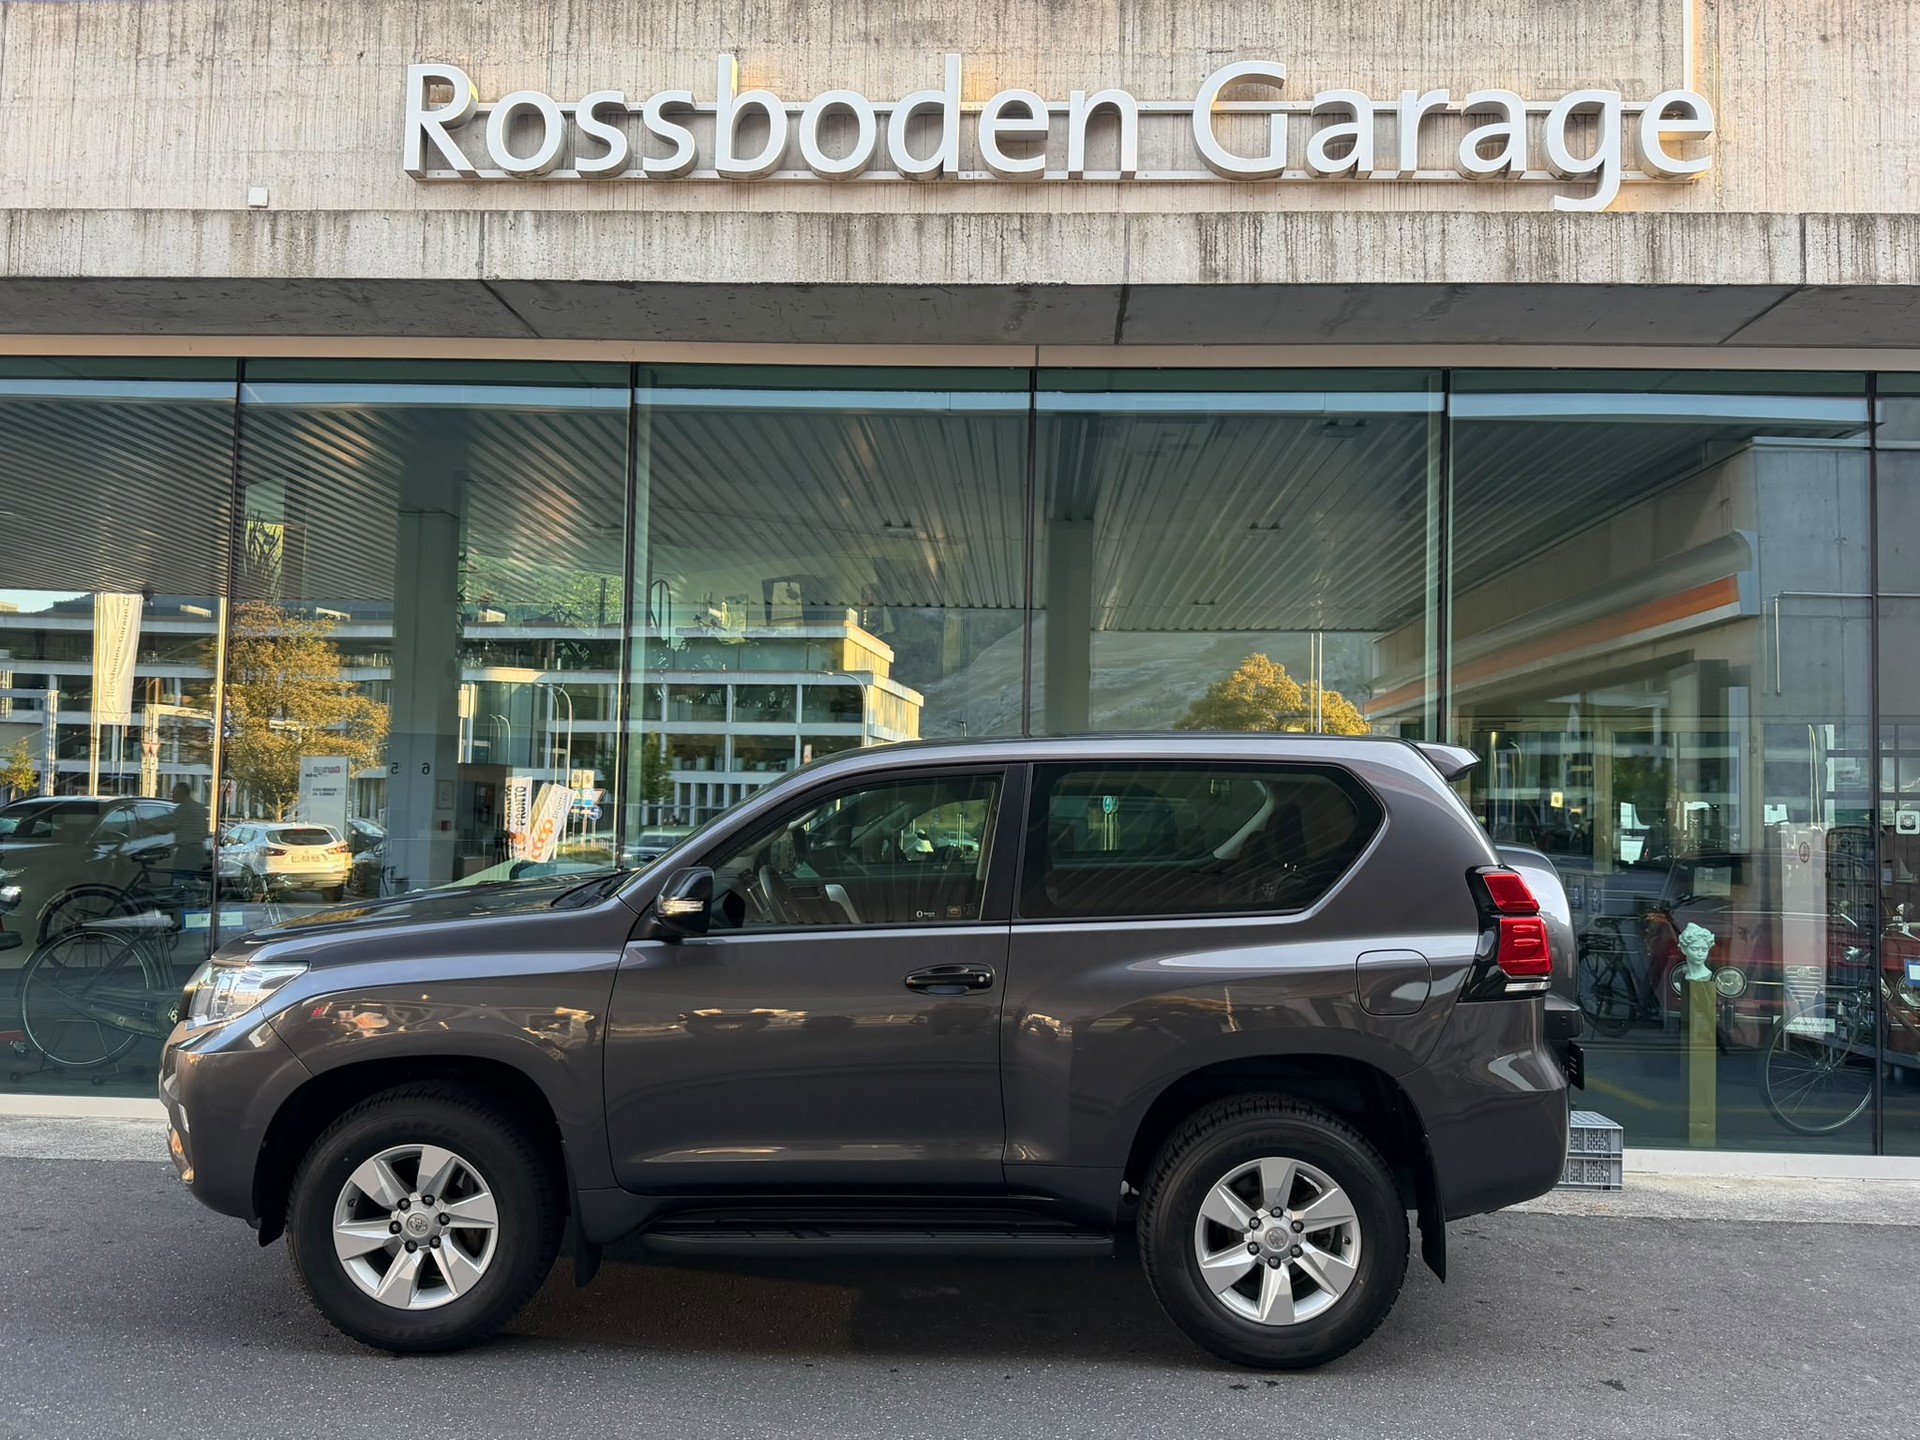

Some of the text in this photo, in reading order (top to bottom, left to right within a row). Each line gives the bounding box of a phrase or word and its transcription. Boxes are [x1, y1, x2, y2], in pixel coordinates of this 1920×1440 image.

[403, 53, 1715, 211] Rossboden Garage
[515, 785, 527, 827] PRONTO
[531, 819, 554, 860] coop
